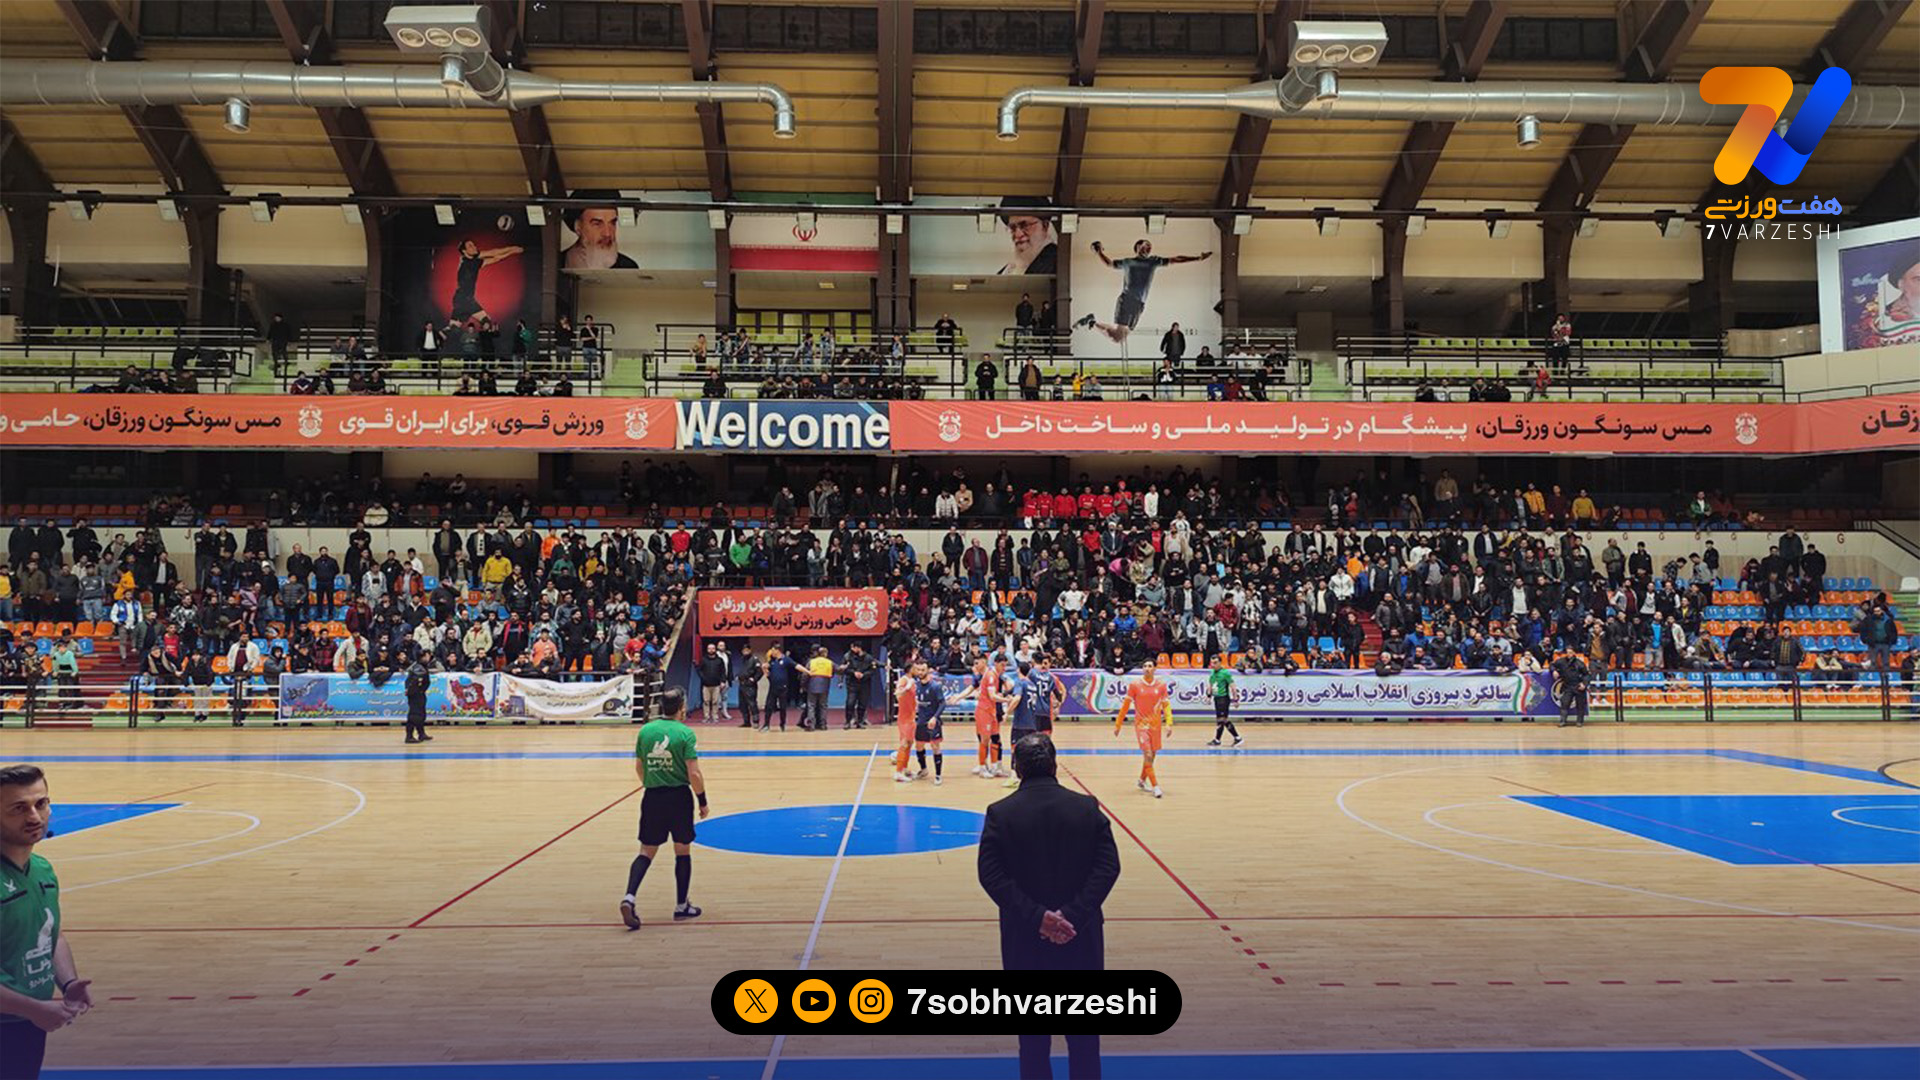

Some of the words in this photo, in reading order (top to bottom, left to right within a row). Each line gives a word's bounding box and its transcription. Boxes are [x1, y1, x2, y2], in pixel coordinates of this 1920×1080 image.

[11, 408, 80, 433] حامی
[149, 407, 232, 433] سونگون
[235, 416, 282, 433] مس
[339, 407, 394, 435] قوی
[396, 409, 449, 436] ایران
[451, 410, 489, 436] برای
[553, 412, 604, 436] ورزش
[675, 401, 890, 449] Welcome
[985, 415, 1052, 439] داخل
[1056, 414, 1148, 434] ساخت
[1151, 421, 1161, 439] و
[1165, 415, 1231, 440] ملی
[1235, 415, 1330, 439] تولید
[1332, 419, 1354, 440] در
[1357, 414, 1468, 441] پیشگام
[1553, 415, 1657, 441] سونگون
[1662, 424, 1713, 441] مس
[713, 596, 747, 613] ورزقان
[749, 596, 792, 613] سونگون
[792, 600, 817, 613] مس
[817, 596, 853, 612] باشگاه
[713, 615, 743, 631] شرقی
[744, 613, 793, 630] آذربایجان
[794, 617, 824, 631] ورزش
[825, 614, 853, 630] حامی
[1269, 685, 1293, 702] روز
[1296, 688, 1305, 702] و
[1307, 683, 1361, 703] اسلامی
[1363, 683, 1409, 704] انقلاب
[1411, 687, 1460, 706] پیروزی
[1462, 684, 1512, 705] سالگرد
